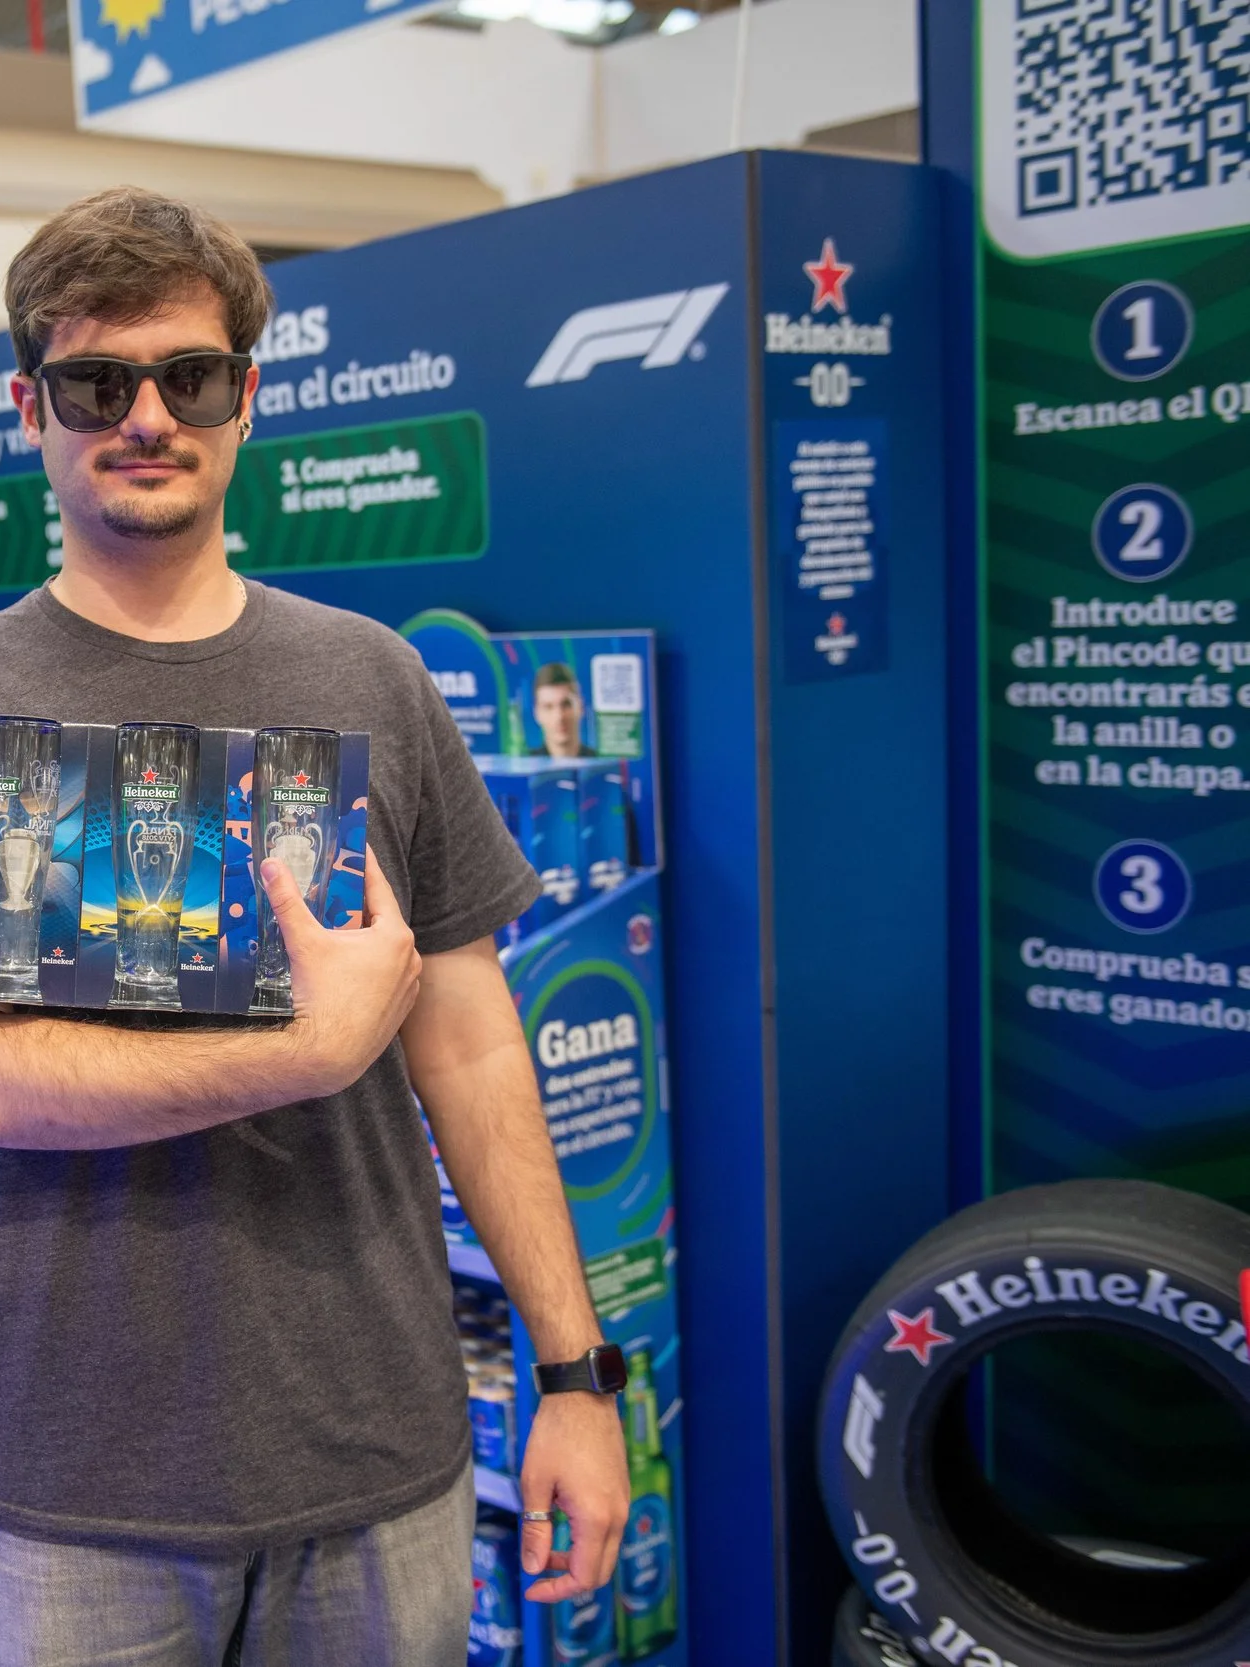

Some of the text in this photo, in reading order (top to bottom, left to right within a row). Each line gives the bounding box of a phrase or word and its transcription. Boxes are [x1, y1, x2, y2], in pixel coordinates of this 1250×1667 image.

[765, 313, 892, 355] Heineken
[1122, 297, 1163, 361] 1
[257, 348, 456, 417] en el circuito
[1014, 397, 1161, 436] Escanea
[1168, 386, 1206, 422] el
[1118, 500, 1164, 562] 2
[1051, 594, 1237, 628] Introduce
[1012, 636, 1047, 669] el
[1052, 635, 1199, 669] Pincode
[1005, 675, 1230, 708] encontrarás
[1052, 714, 1235, 750] la anilla o
[1034, 758, 1081, 785] en
[1086, 754, 1122, 787] la
[124, 786, 177, 799] Heineken
[273, 790, 327, 802] Heineken
[1119, 854, 1164, 914] 3
[41, 956, 75, 966] Heineken
[180, 963, 215, 972] Heineken
[1020, 937, 1231, 988] Comprueba
[1026, 983, 1104, 1014] eres
[537, 1013, 638, 1068] Gana
